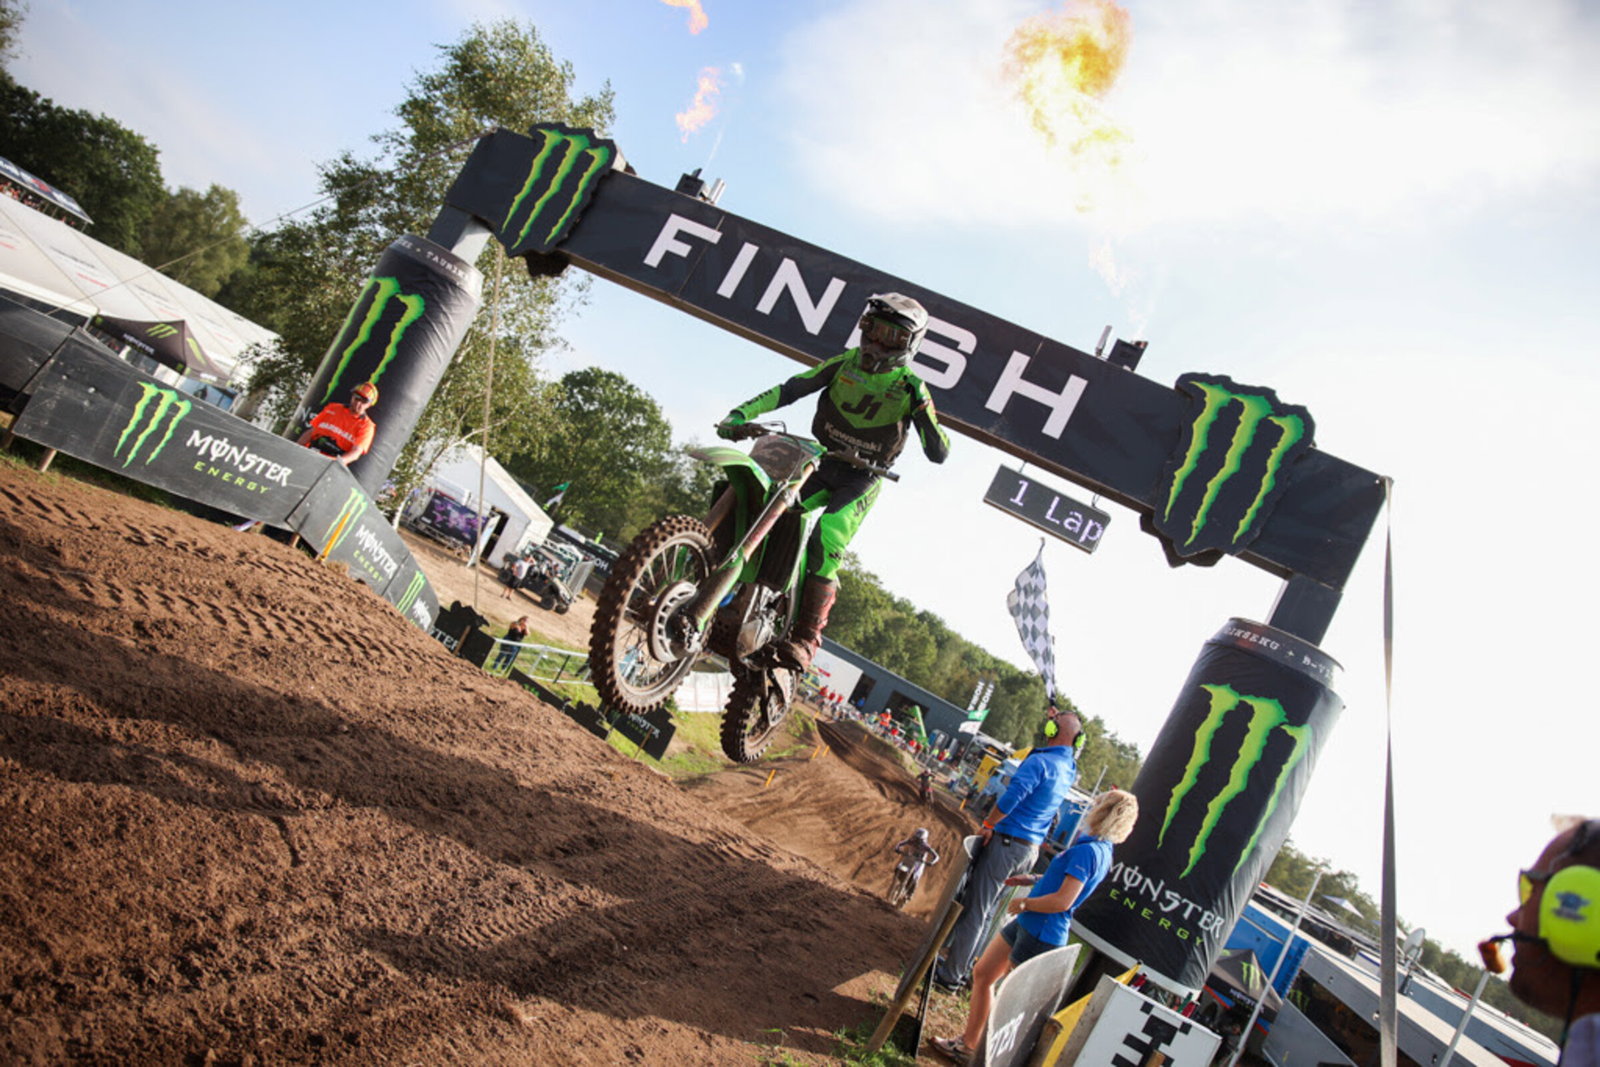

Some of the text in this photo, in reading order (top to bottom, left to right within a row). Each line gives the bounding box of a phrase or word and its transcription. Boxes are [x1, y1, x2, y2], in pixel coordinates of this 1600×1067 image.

[643, 213, 1088, 439] FINSH
[186, 429, 292, 487] MONSTER
[194, 461, 268, 494] ENERGY
[1009, 480, 1103, 543] 1 Lap
[1109, 888, 1205, 946] ENERGY
